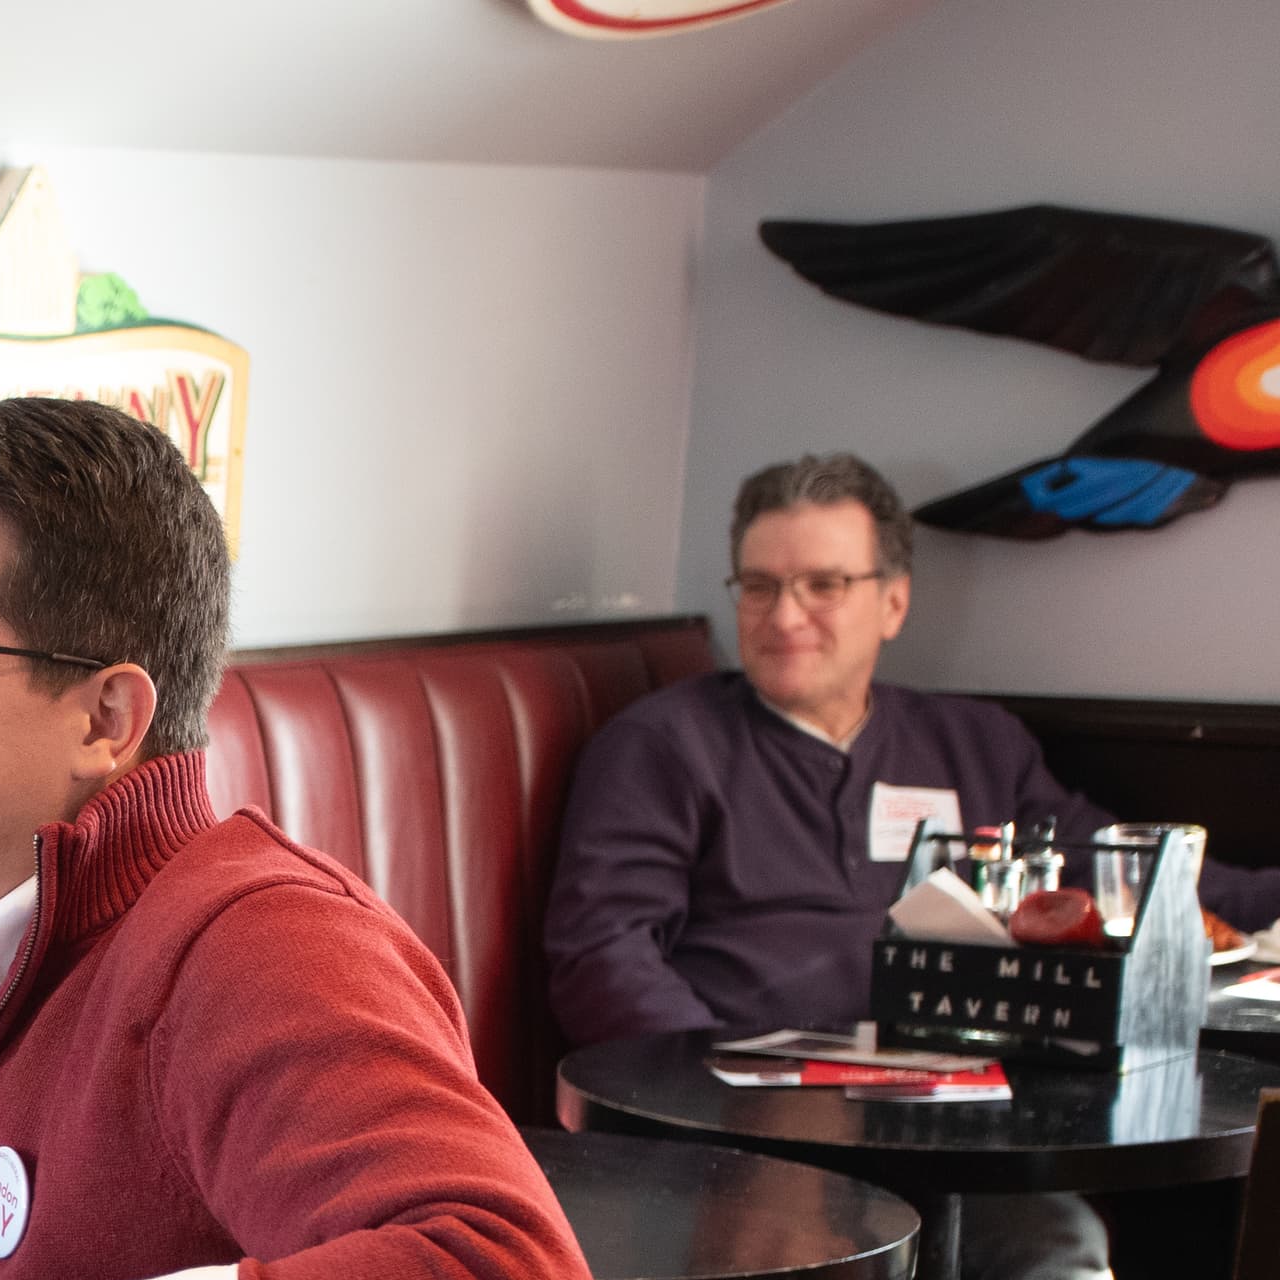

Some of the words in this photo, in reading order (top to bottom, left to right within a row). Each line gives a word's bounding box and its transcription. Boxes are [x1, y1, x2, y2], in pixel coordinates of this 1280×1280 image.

[885, 946, 954, 973] THE
[998, 956, 1102, 988] MILL
[909, 991, 1071, 1029] TAVERN
